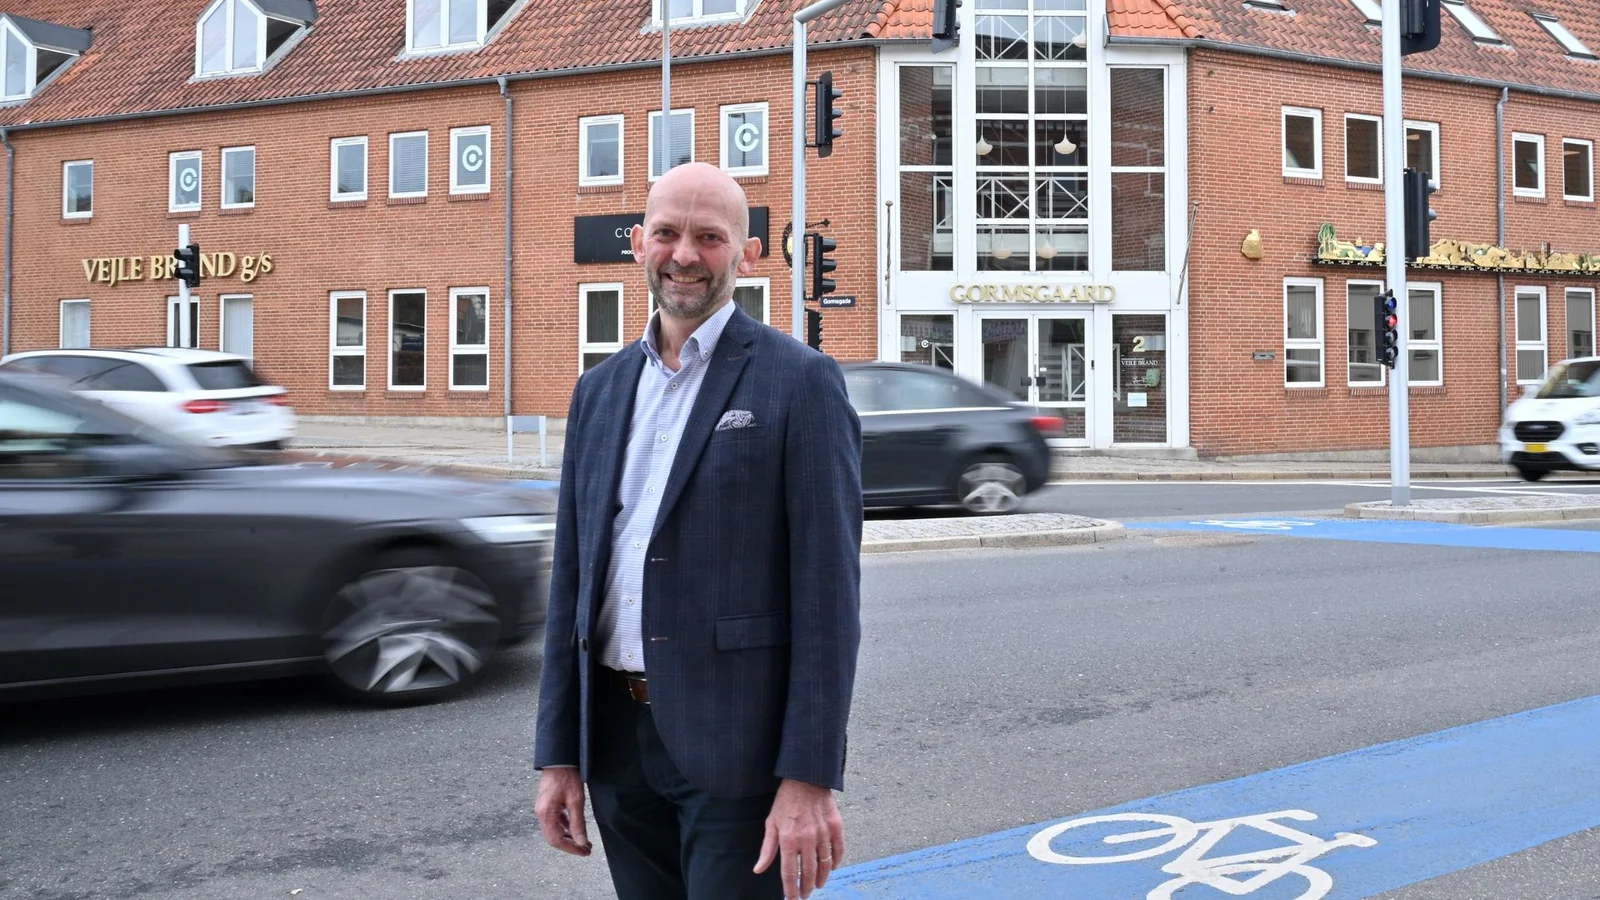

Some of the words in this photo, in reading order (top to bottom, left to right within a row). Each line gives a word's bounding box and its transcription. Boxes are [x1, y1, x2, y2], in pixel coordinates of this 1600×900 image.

[82, 256, 143, 287] VEJLE
[150, 252, 236, 279] BRND
[240, 251, 272, 282] g/s
[950, 284, 1117, 303] GORMSGAARD
[1132, 336, 1145, 352] 2
